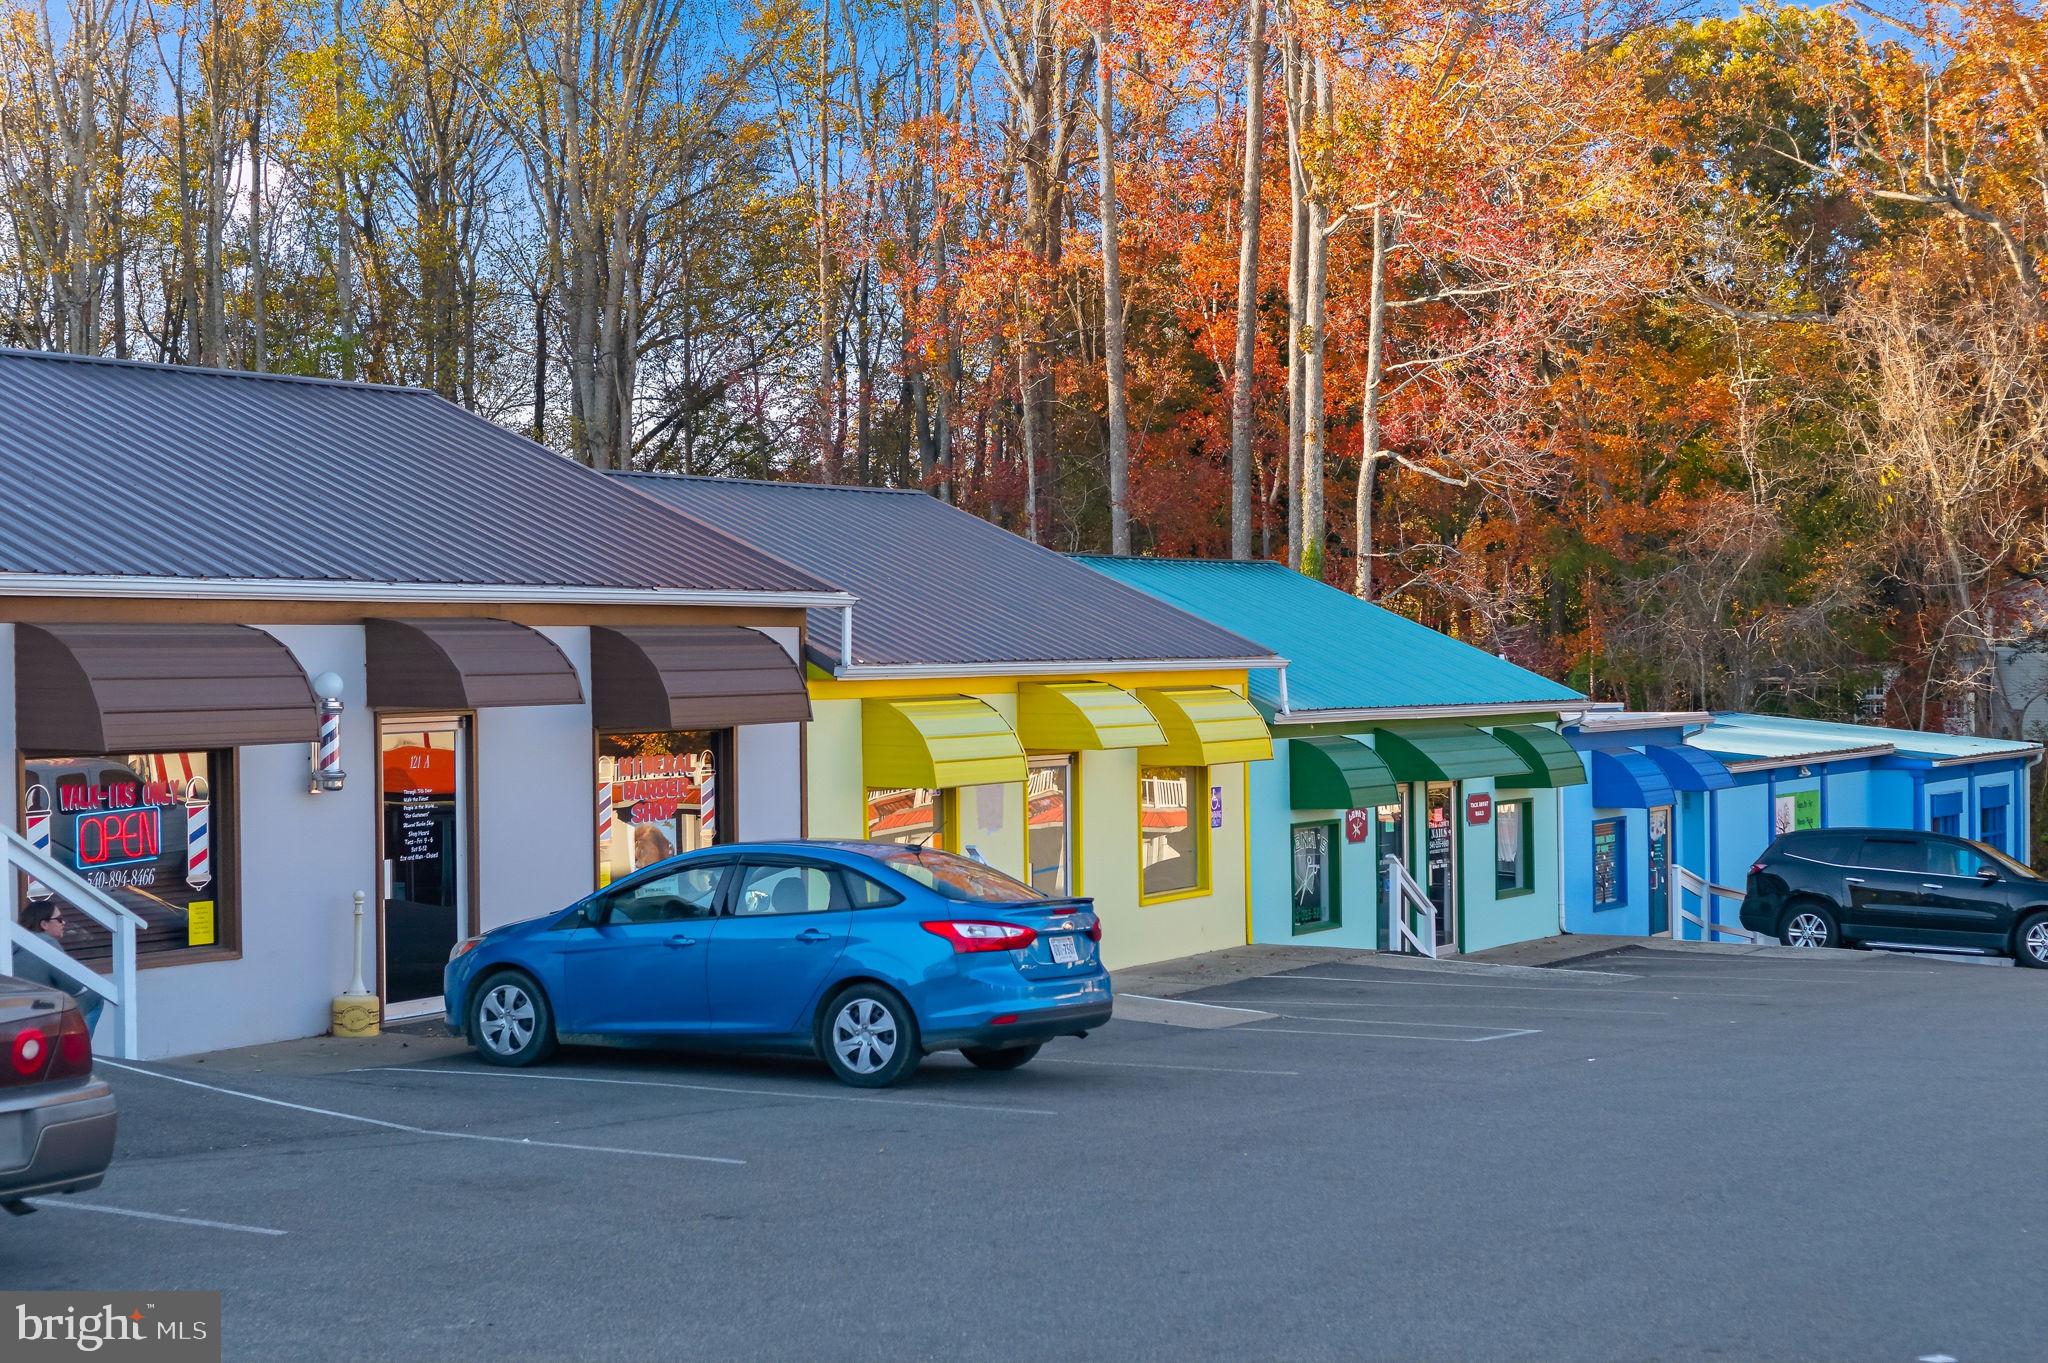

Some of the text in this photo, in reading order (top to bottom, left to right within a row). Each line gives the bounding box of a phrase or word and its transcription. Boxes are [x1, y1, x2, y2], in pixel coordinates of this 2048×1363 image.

[409, 754, 430, 769] 121 A
[617, 753, 696, 779] MINERAL
[60, 779, 180, 812] WALK-INS ONLY
[622, 777, 689, 801] BARBER
[631, 800, 677, 824] SHOP
[80, 811, 158, 863] OPEN
[1294, 831, 1328, 855] ENA'S
[88, 868, 156, 889] 540-894-8466
